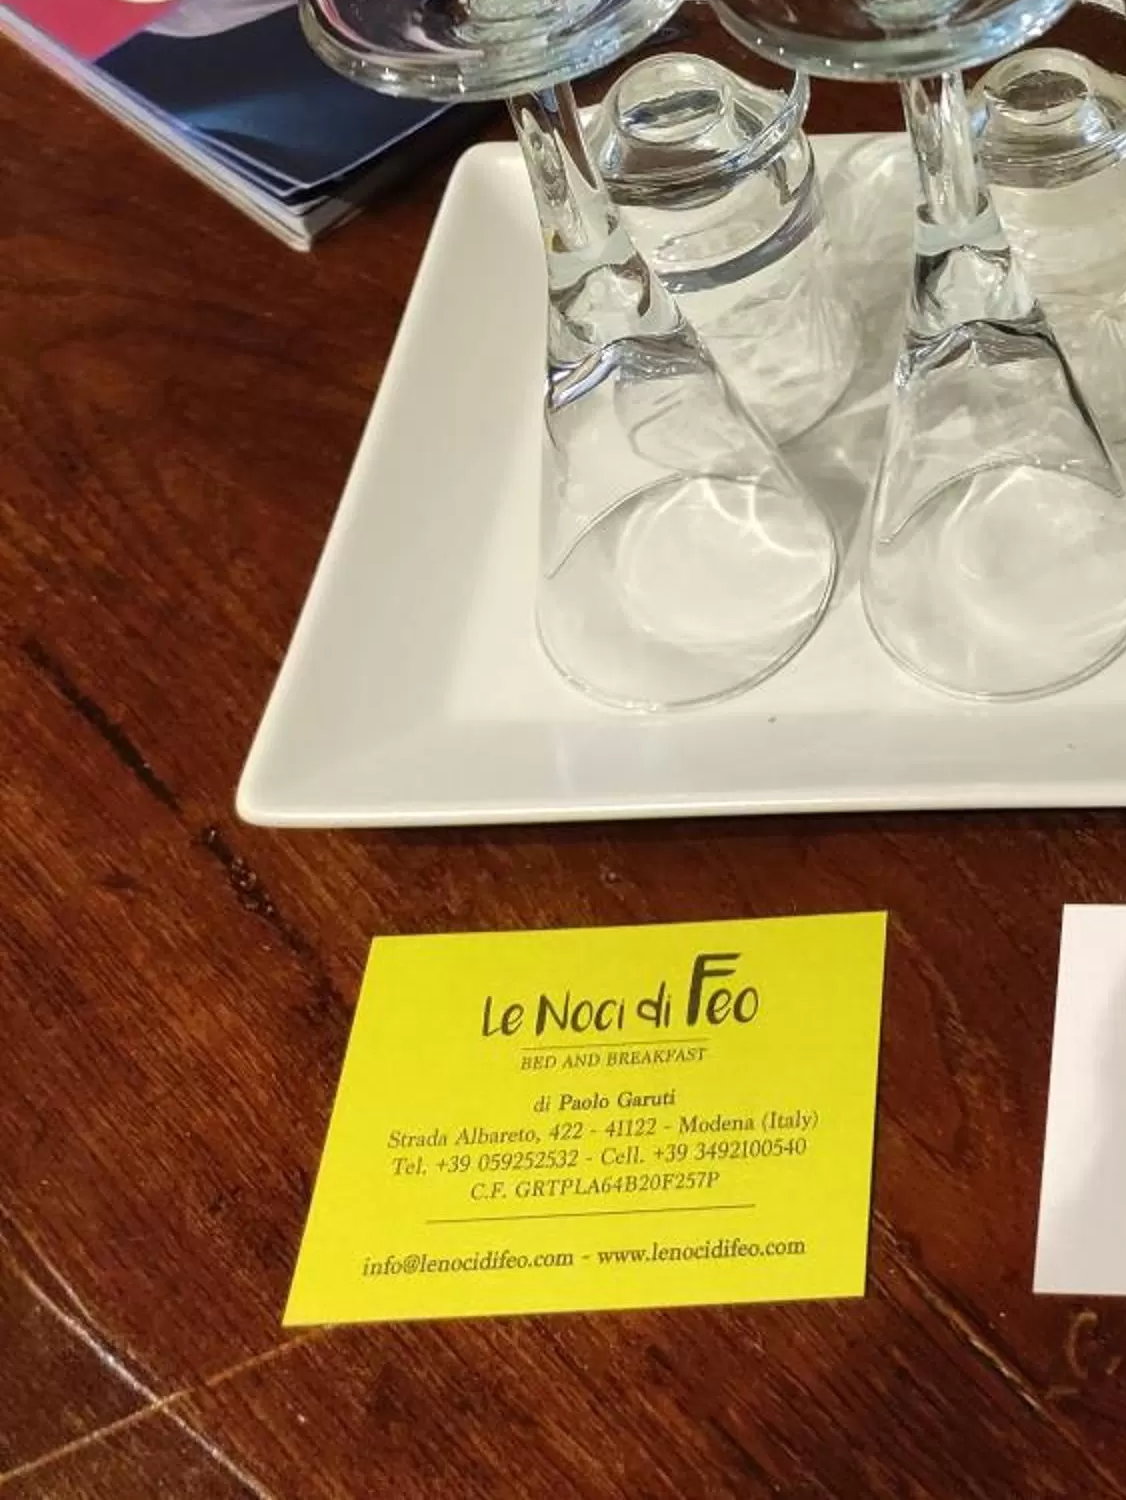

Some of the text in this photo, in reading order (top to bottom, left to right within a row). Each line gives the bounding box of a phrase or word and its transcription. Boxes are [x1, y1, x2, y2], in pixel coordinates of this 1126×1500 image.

[482, 952, 761, 1037] Le Noci di Feo
[520, 1047, 707, 1070] BED AND BREAKFAST
[533, 1087, 677, 1114] di Paolo Garuti
[388, 1127, 449, 1150] Strada
[453, 1123, 542, 1148] Albareto,
[549, 1121, 584, 1141] 422
[605, 1117, 658, 1137] 41122
[678, 1112, 756, 1135] Modena
[762, 1108, 819, 1132] (Italy)
[391, 1155, 430, 1176] Tel.
[435, 1153, 472, 1173] +39
[477, 1149, 579, 1172] 059252532
[600, 1145, 645, 1166] Cell.
[653, 1141, 689, 1163] +39
[694, 1136, 807, 1162] 3492100540
[470, 1170, 720, 1201] C.F. GRTPLA64B20F257P
[362, 1249, 575, 1278] info@lenocidifeo.com
[597, 1236, 806, 1265] www.lenocidifeo.com
